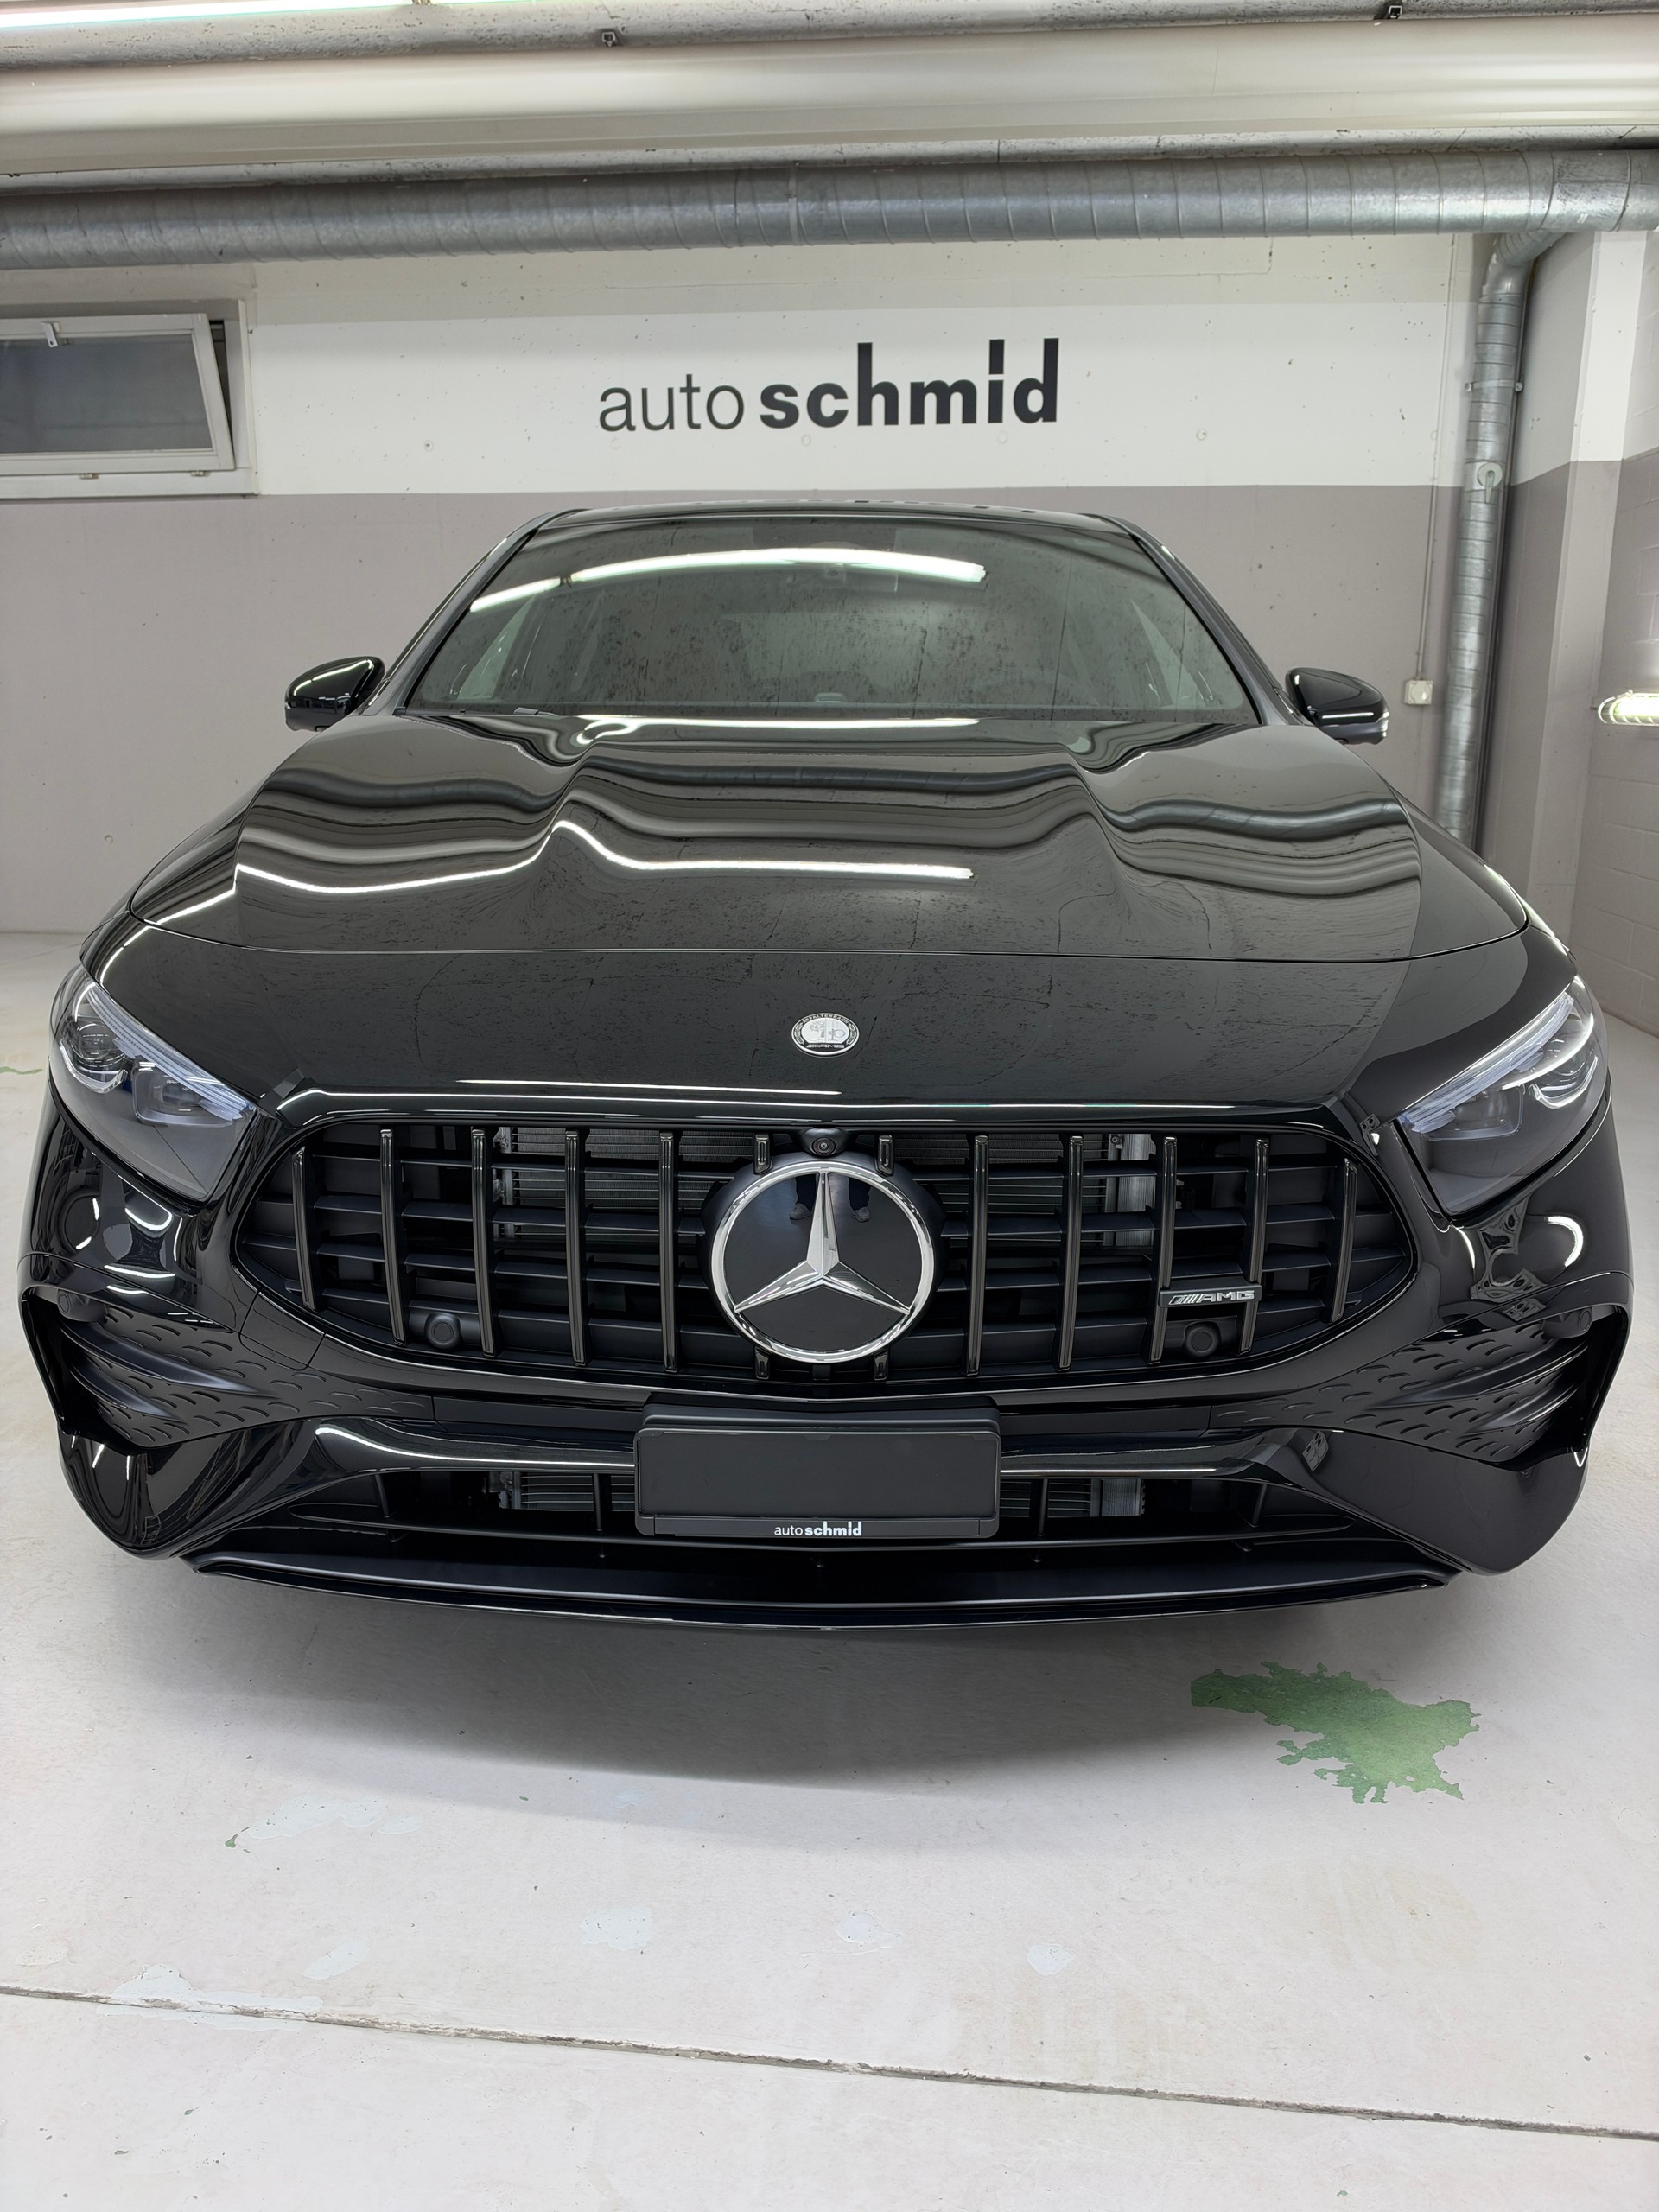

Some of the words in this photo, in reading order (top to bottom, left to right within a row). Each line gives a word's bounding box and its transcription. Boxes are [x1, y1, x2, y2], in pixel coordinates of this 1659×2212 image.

[599, 373, 745, 432] auto
[759, 337, 1059, 429] schmid
[1195, 1289, 1255, 1304] AMG
[773, 1524, 804, 1536] auto
[804, 1520, 862, 1536] schmid
